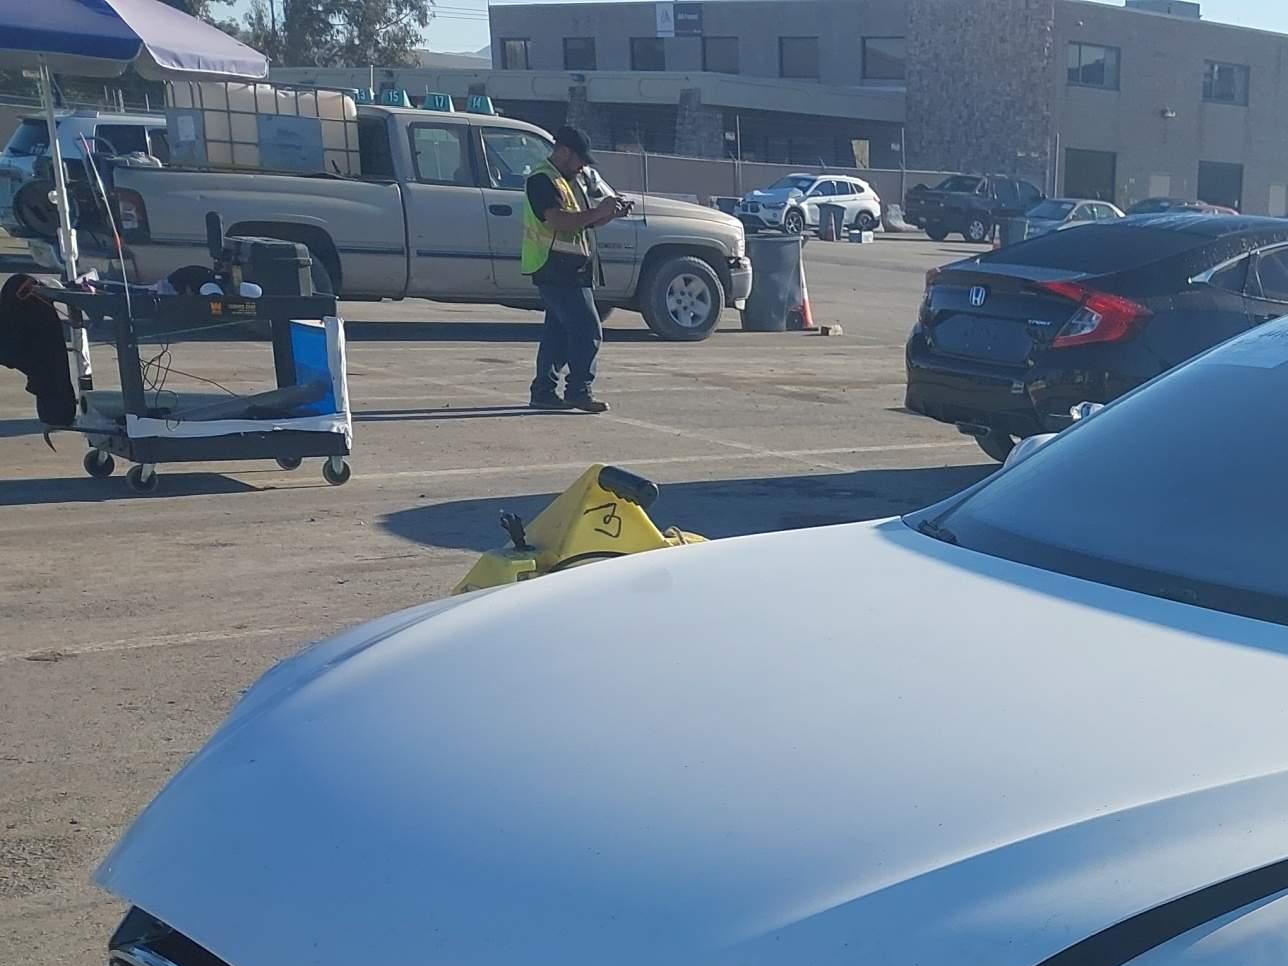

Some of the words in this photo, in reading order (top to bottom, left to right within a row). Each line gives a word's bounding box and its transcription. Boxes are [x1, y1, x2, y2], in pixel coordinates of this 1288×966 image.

[389, 91, 399, 102] 15
[435, 95, 444, 107] 17
[472, 97, 481, 107] 14
[583, 502, 622, 538] 3
